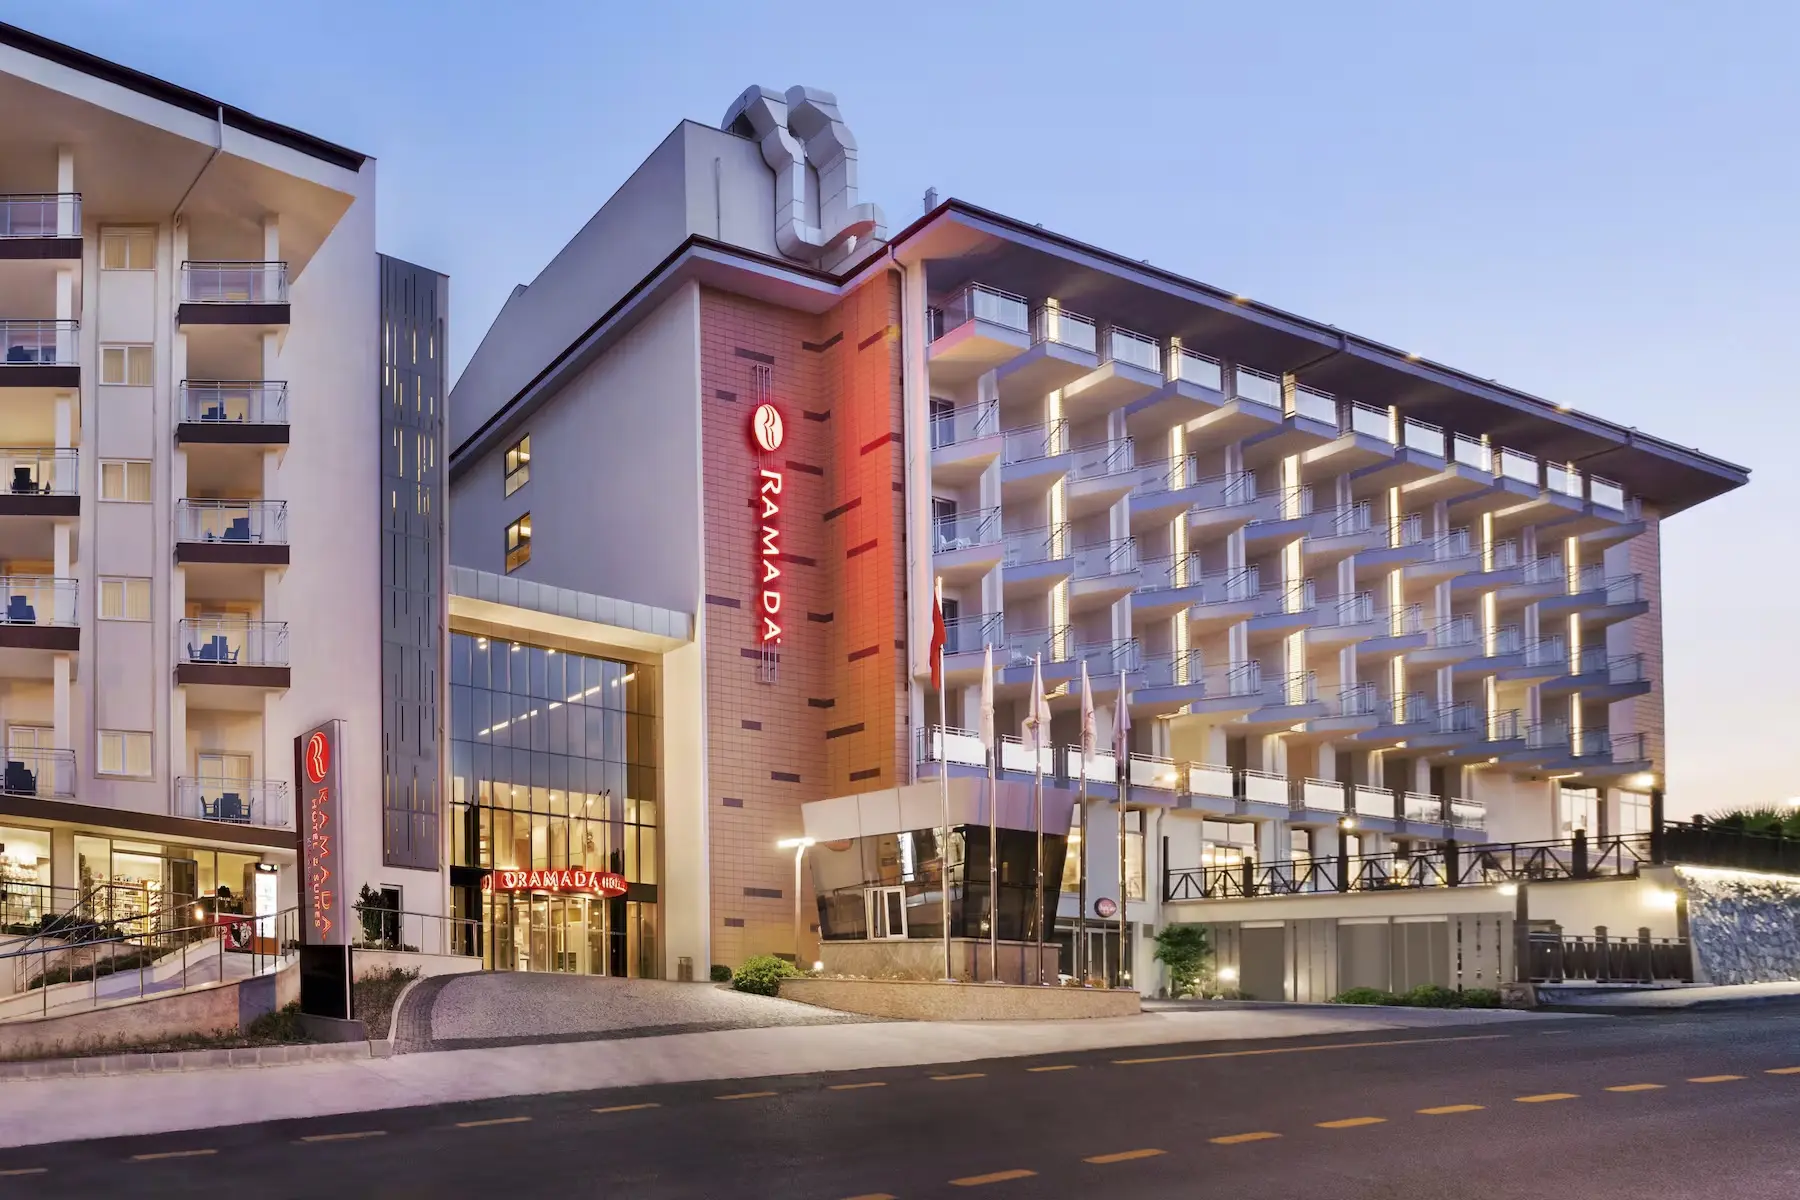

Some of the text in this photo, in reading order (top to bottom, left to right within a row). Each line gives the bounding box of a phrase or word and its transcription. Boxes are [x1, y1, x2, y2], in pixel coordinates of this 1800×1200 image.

[760, 469, 783, 643] RAMADA
[311, 799, 319, 849] HOTEL
[318, 787, 332, 937] RAMADA
[517, 870, 598, 888] RAMADA
[313, 874, 321, 928] SUITES
